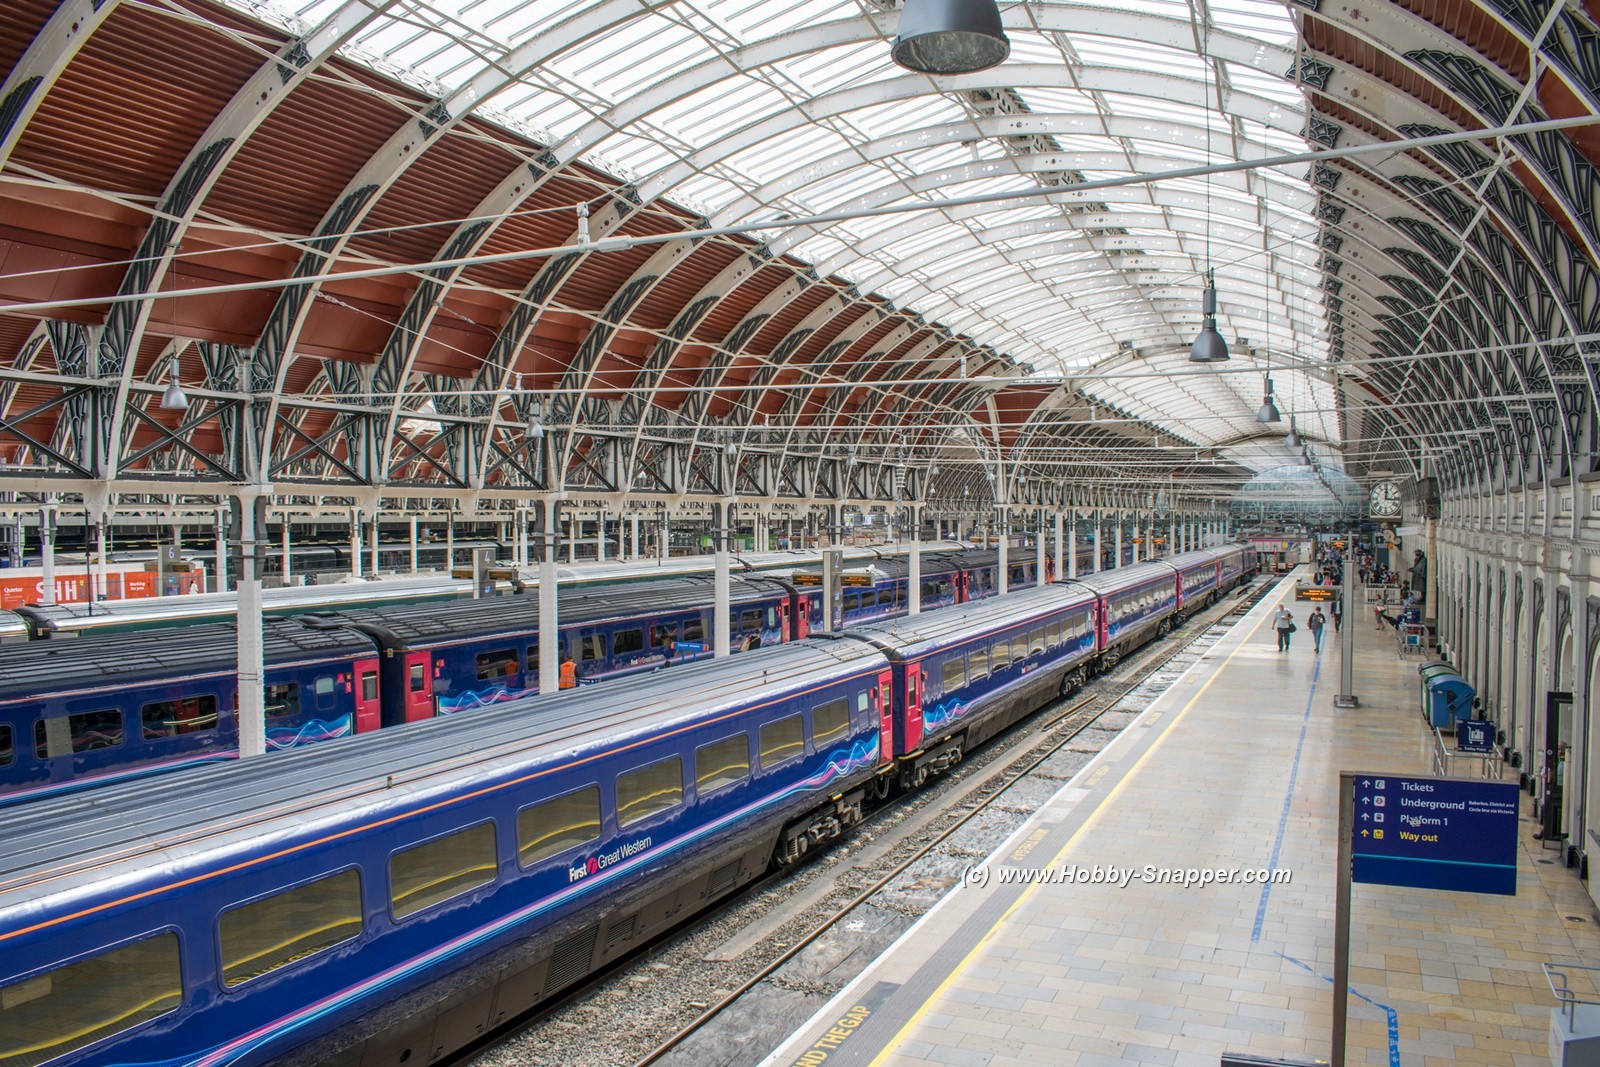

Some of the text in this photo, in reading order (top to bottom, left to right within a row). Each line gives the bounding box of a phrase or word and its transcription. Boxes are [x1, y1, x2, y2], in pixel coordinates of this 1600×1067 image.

[169, 547, 174, 558] 6
[1401, 782, 1434, 792] Tickets
[1401, 798, 1465, 810] Underground
[1443, 818, 1448, 826] 1
[1400, 831, 1438, 842] Way out
[568, 836, 652, 882] First Great Western
[813, 1026, 853, 1050] THE
[837, 1005, 871, 1029] GAP
